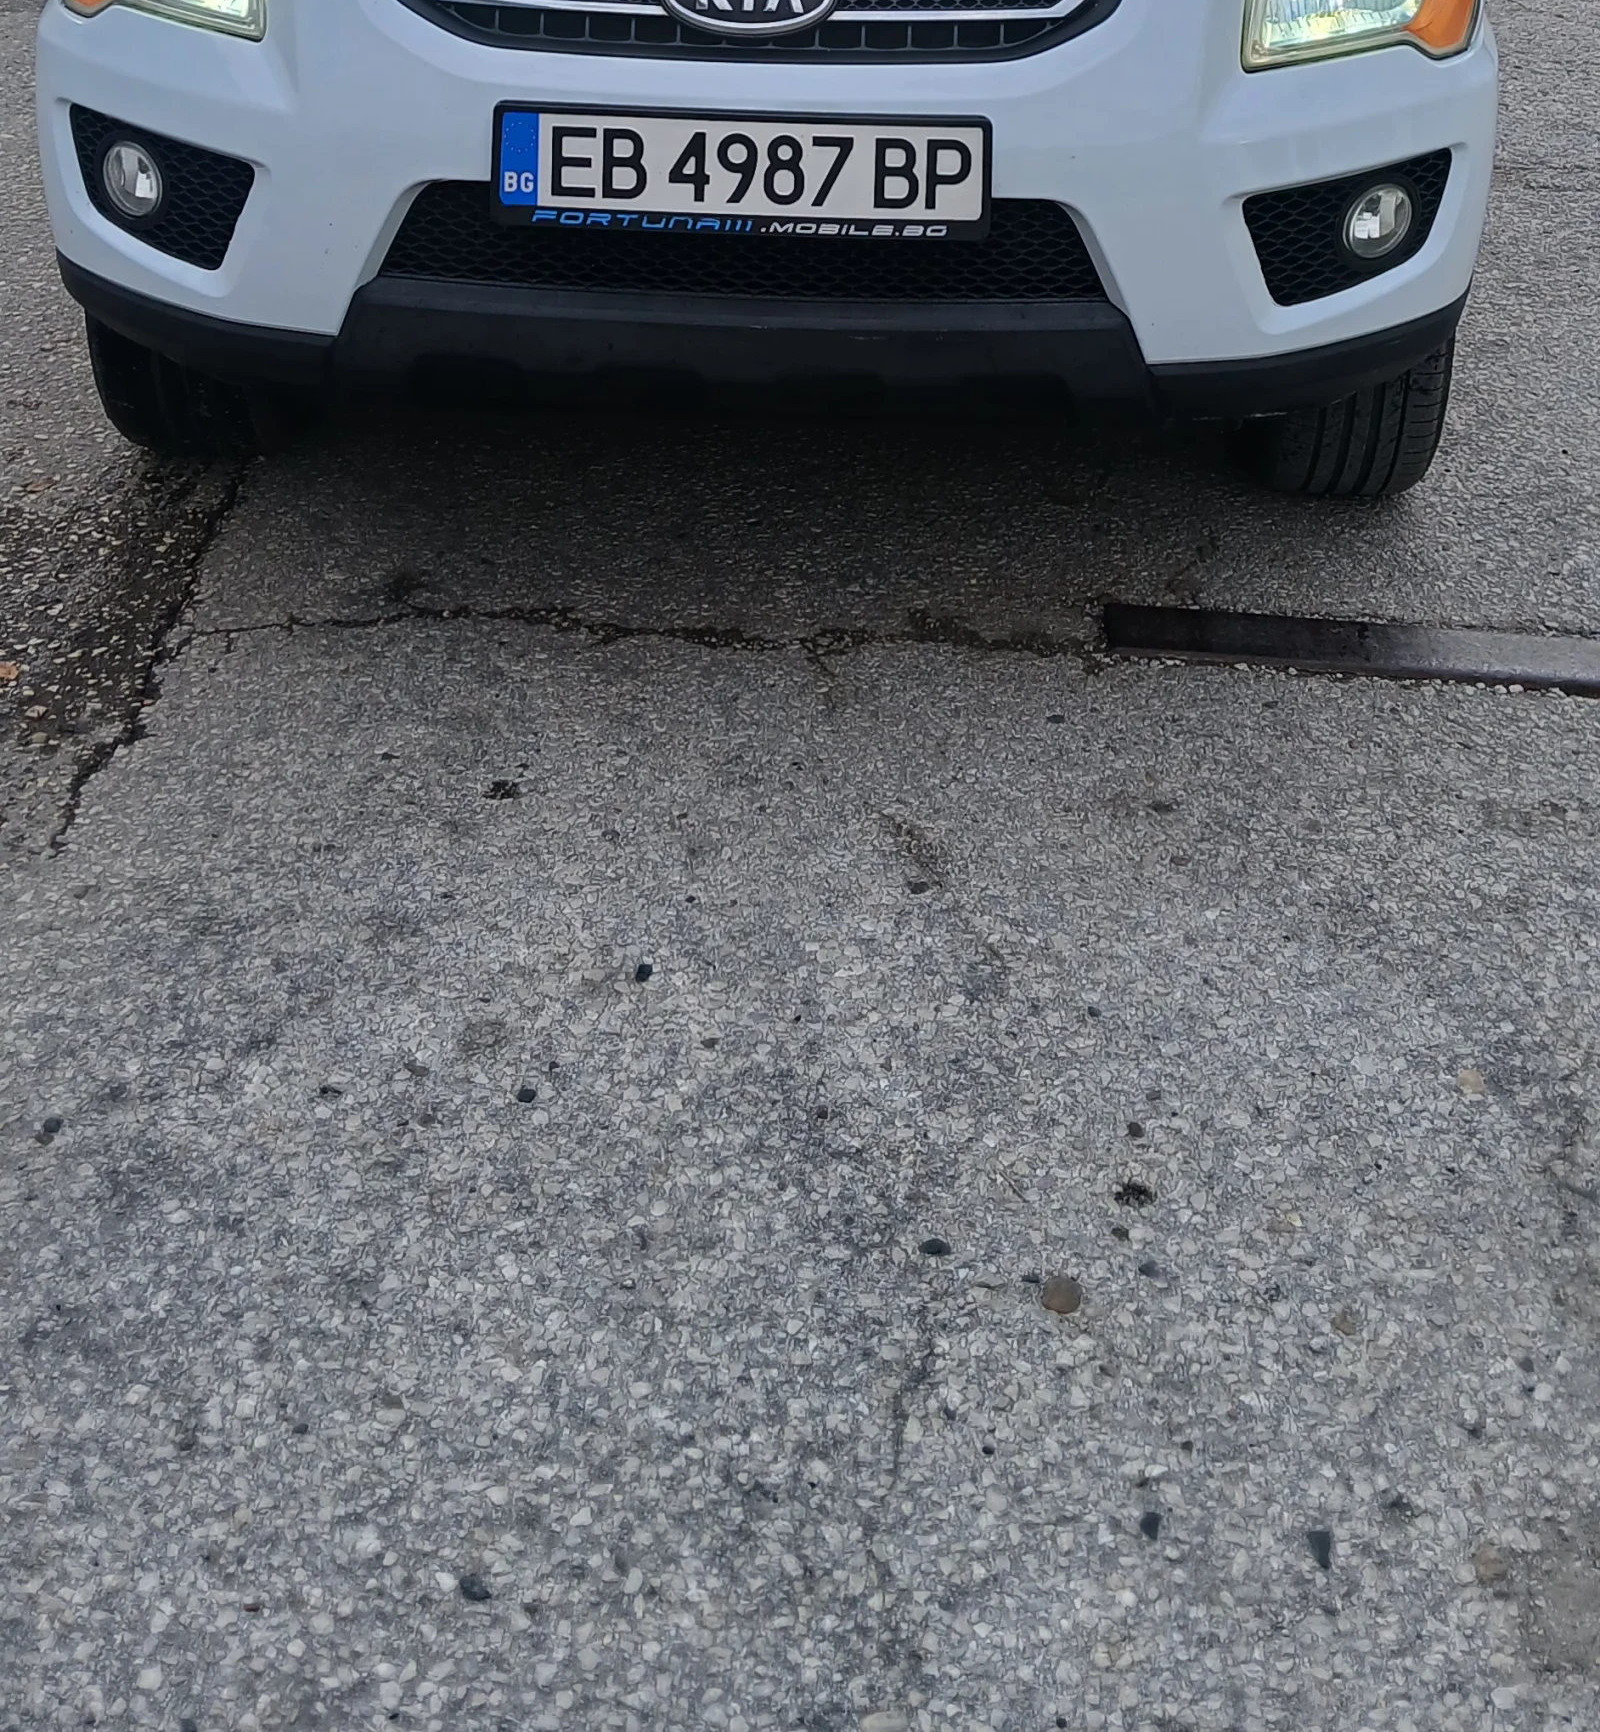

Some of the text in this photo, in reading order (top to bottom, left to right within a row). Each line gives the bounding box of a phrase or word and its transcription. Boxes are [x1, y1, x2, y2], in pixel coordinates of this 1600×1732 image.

[503, 171, 534, 193] BG
[551, 125, 972, 210] EB 4987 BP
